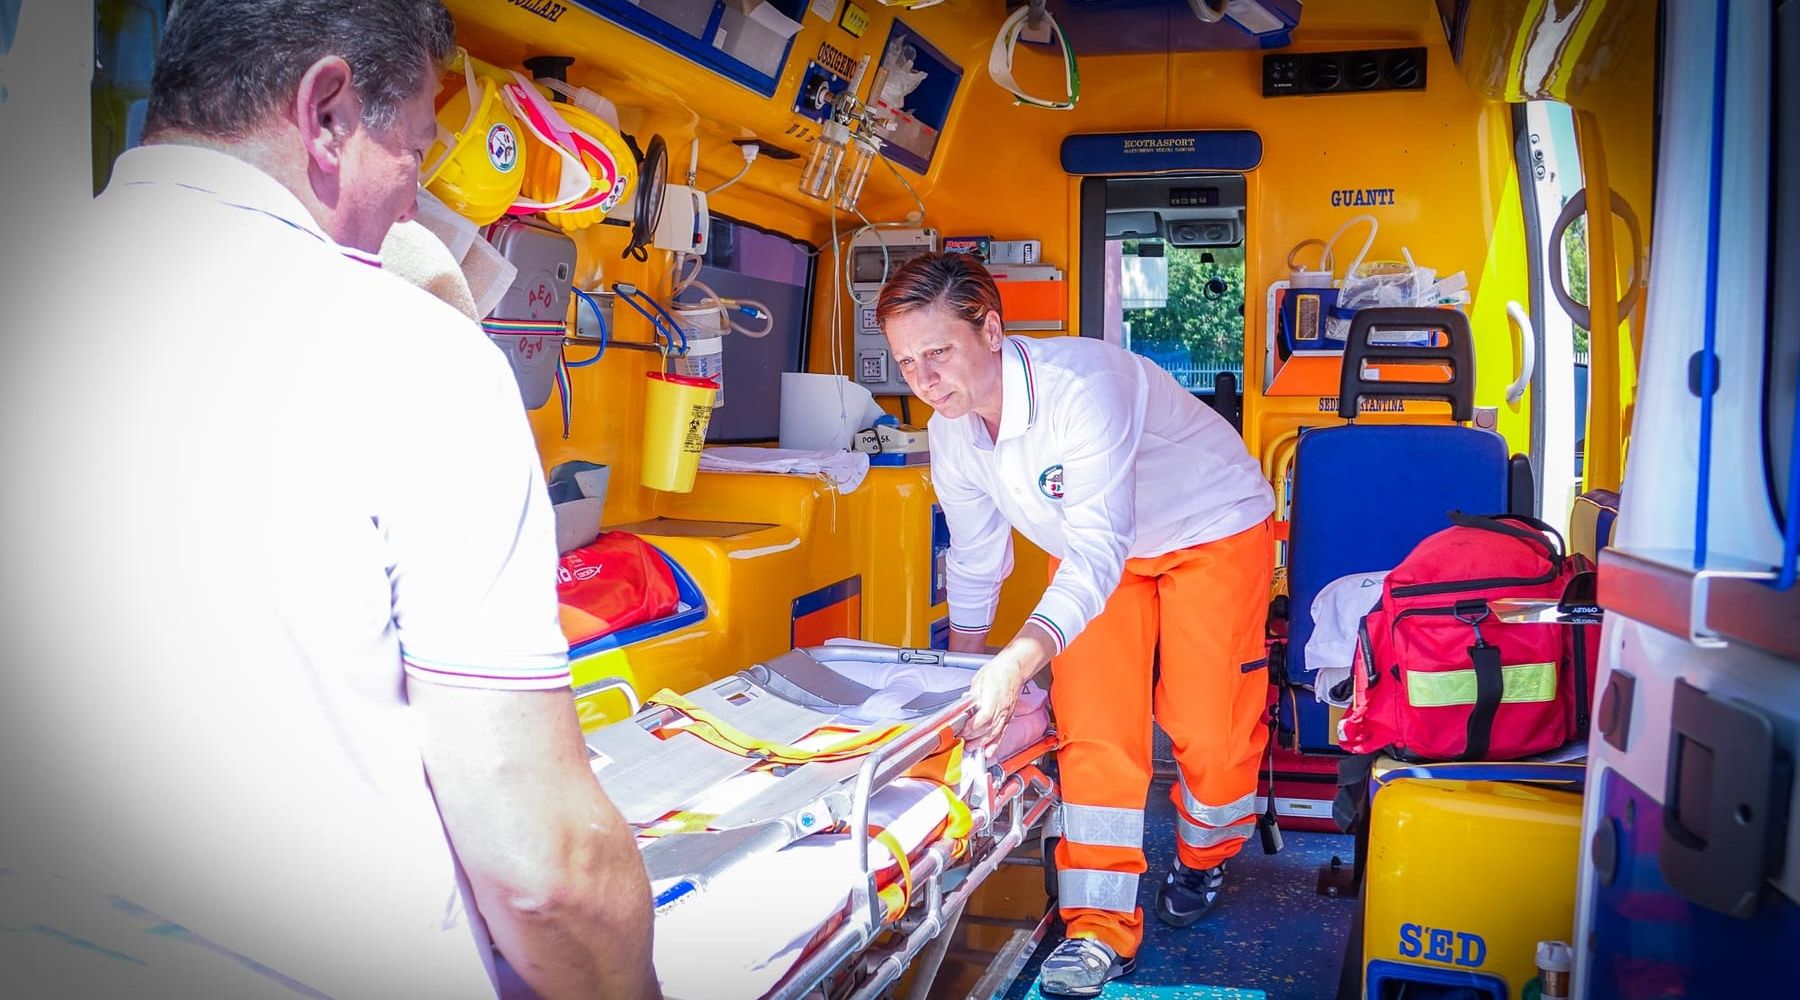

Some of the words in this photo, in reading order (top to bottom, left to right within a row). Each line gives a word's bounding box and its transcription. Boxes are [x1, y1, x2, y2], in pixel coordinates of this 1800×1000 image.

[1124, 138, 1195, 148] ECOTRASPORT
[1331, 188, 1395, 207] GUANTI
[528, 283, 552, 309] AED
[1398, 922, 1487, 968] SED
